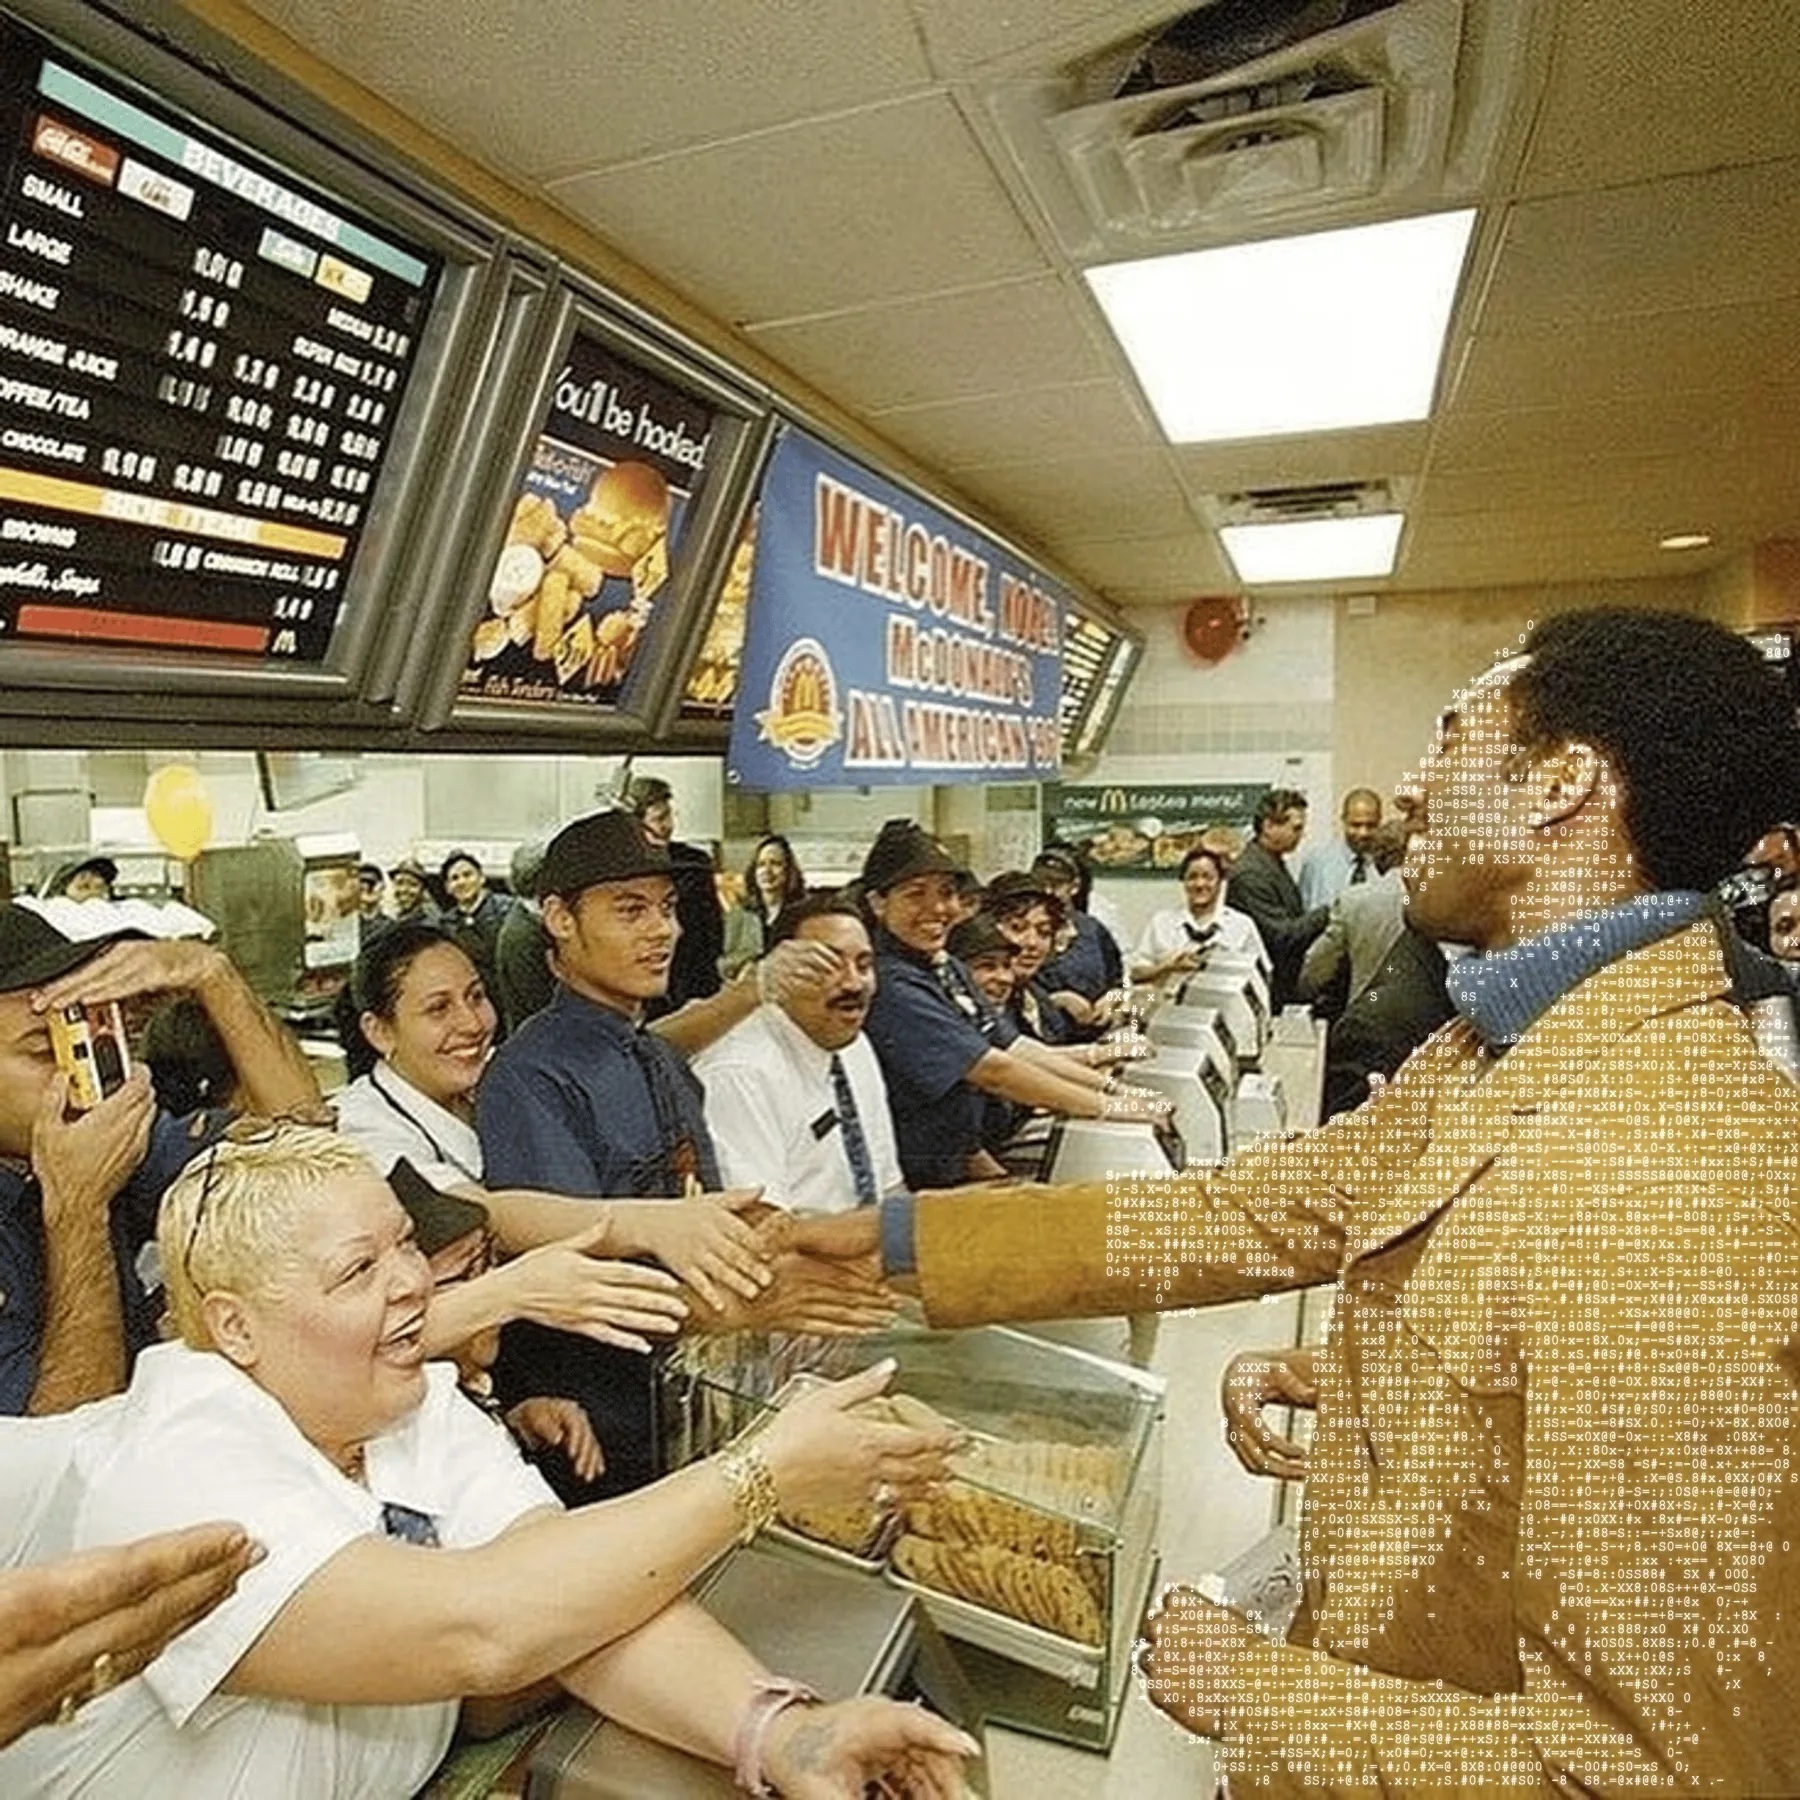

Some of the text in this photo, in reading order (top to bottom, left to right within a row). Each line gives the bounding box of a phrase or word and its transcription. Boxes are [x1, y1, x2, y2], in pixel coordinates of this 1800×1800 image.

[21, 174, 84, 218] SMALL
[7, 223, 73, 265] LARGE
[603, 389, 634, 437] be
[815, 472, 995, 638] WELCOME,
[844, 688, 906, 768] ALL
